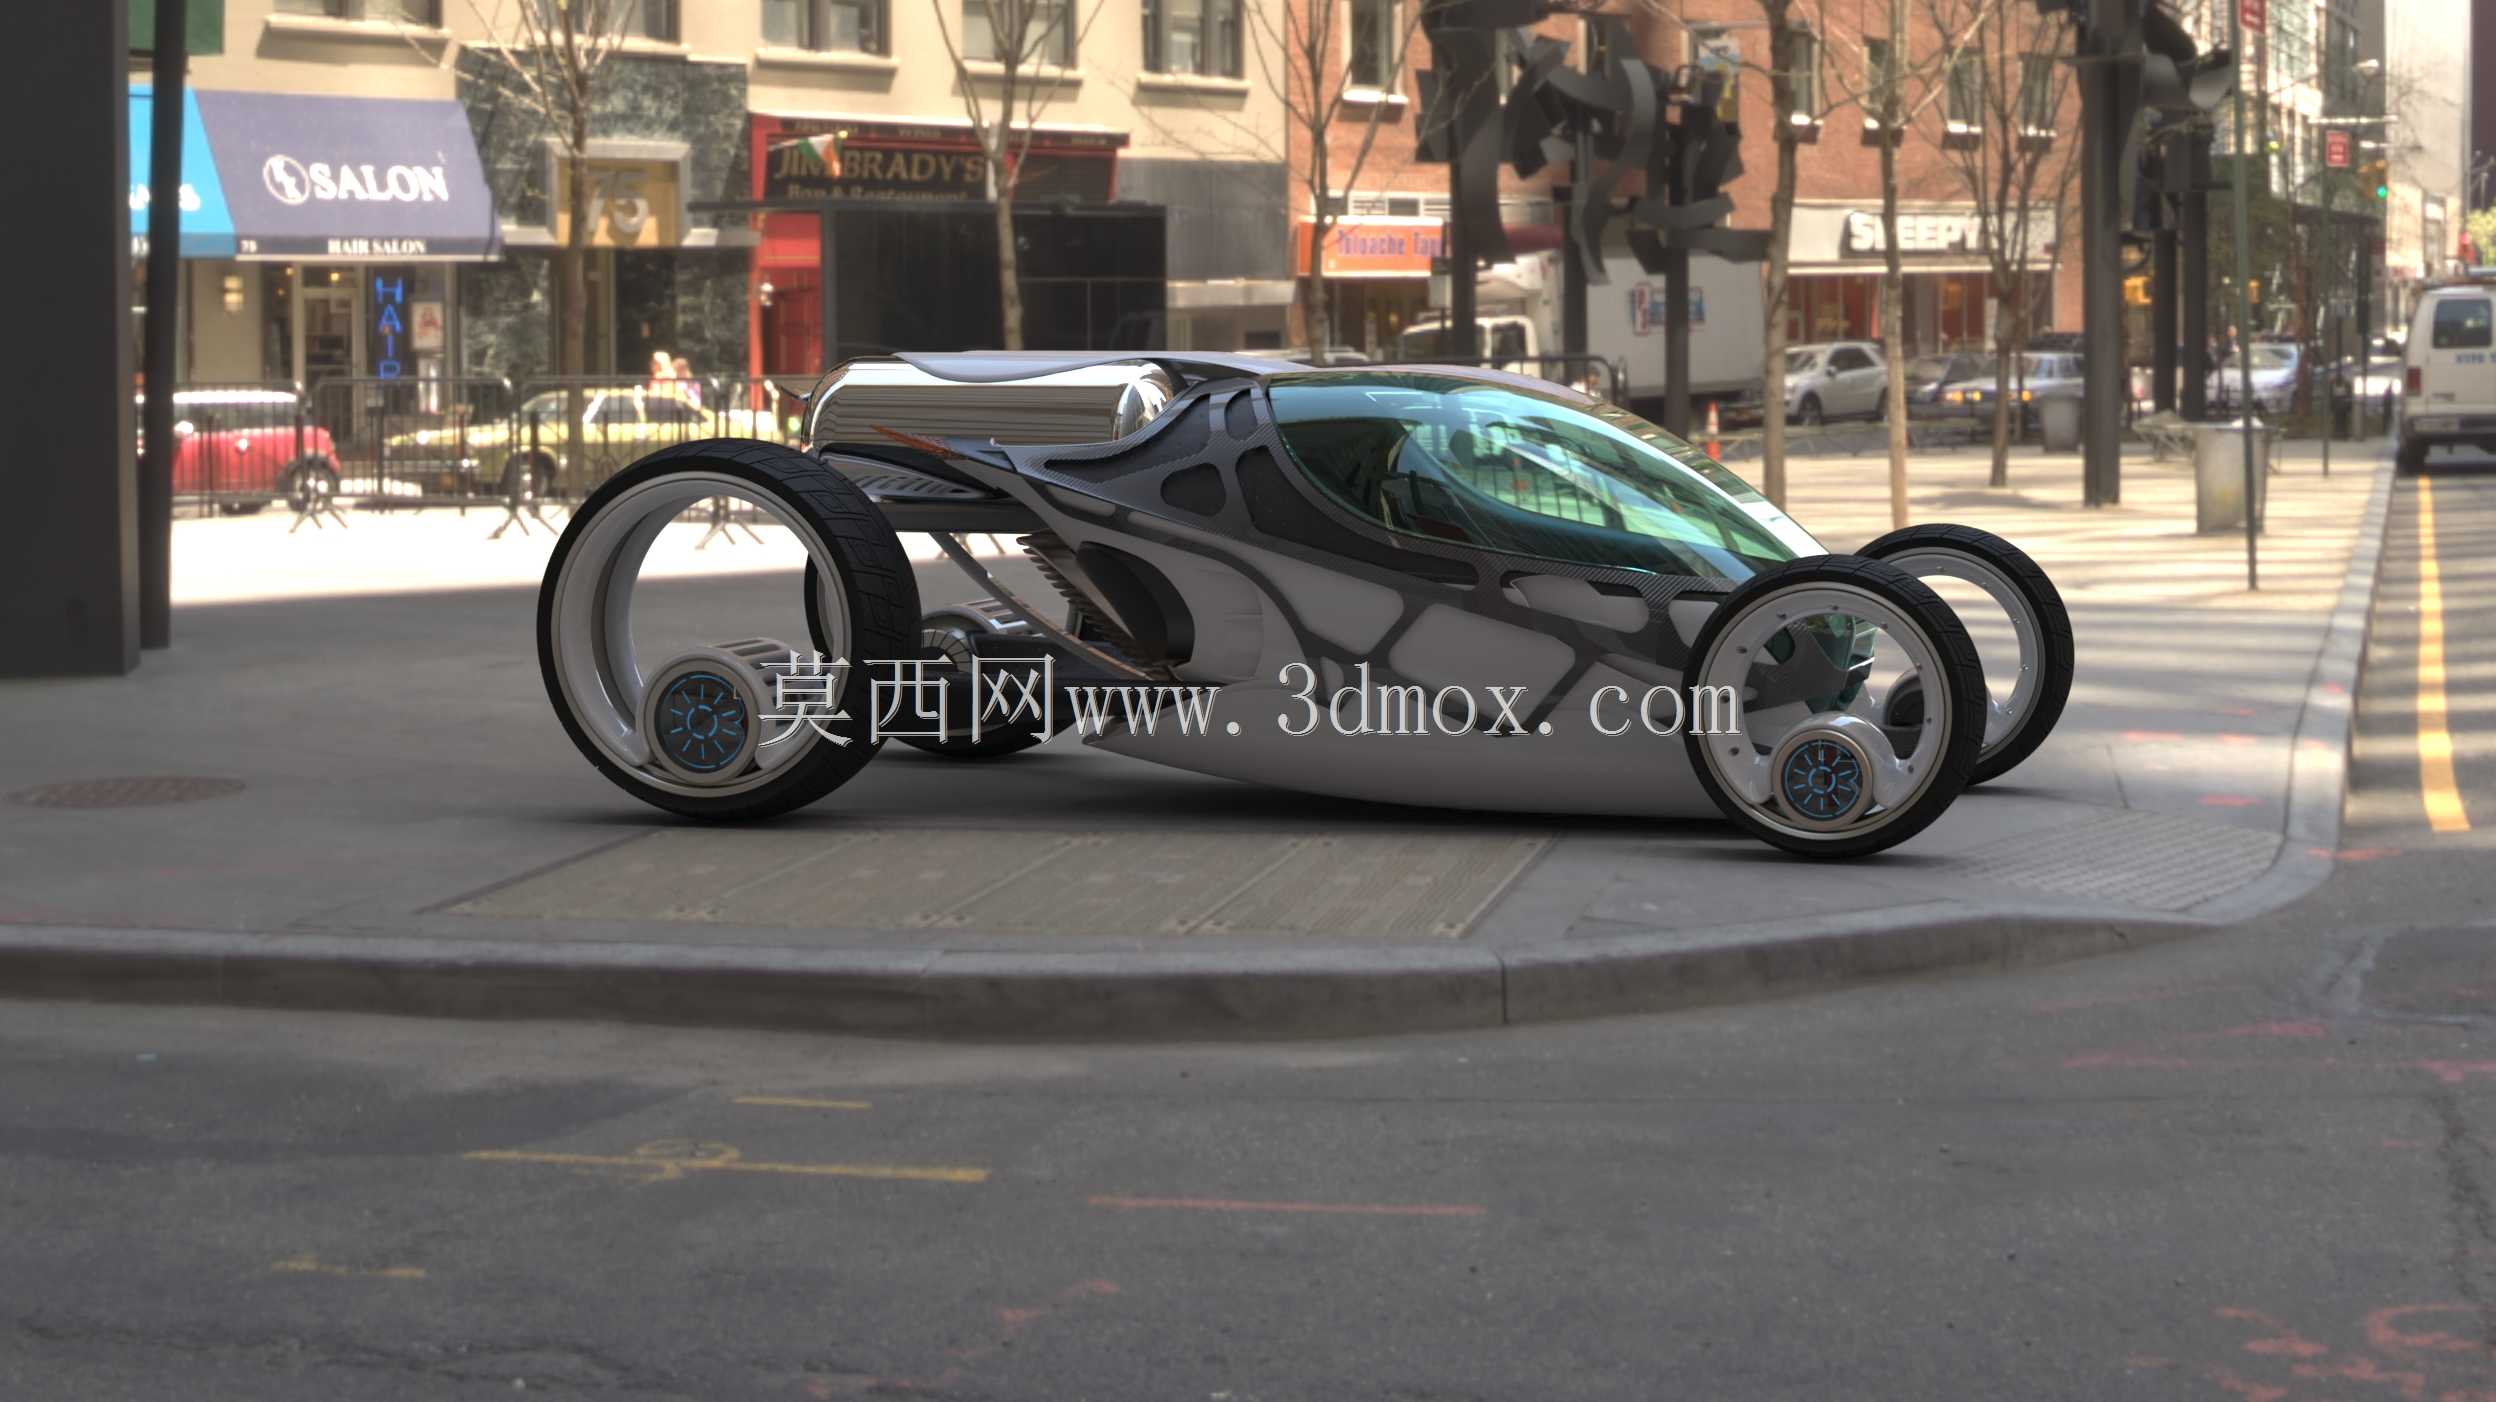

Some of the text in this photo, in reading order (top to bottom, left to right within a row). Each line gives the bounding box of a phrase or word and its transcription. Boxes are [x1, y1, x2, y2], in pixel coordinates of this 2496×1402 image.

[309, 162, 449, 202] SALON
[843, 149, 985, 183] BRADY'S
[327, 237, 427, 255] HAIR SALON
